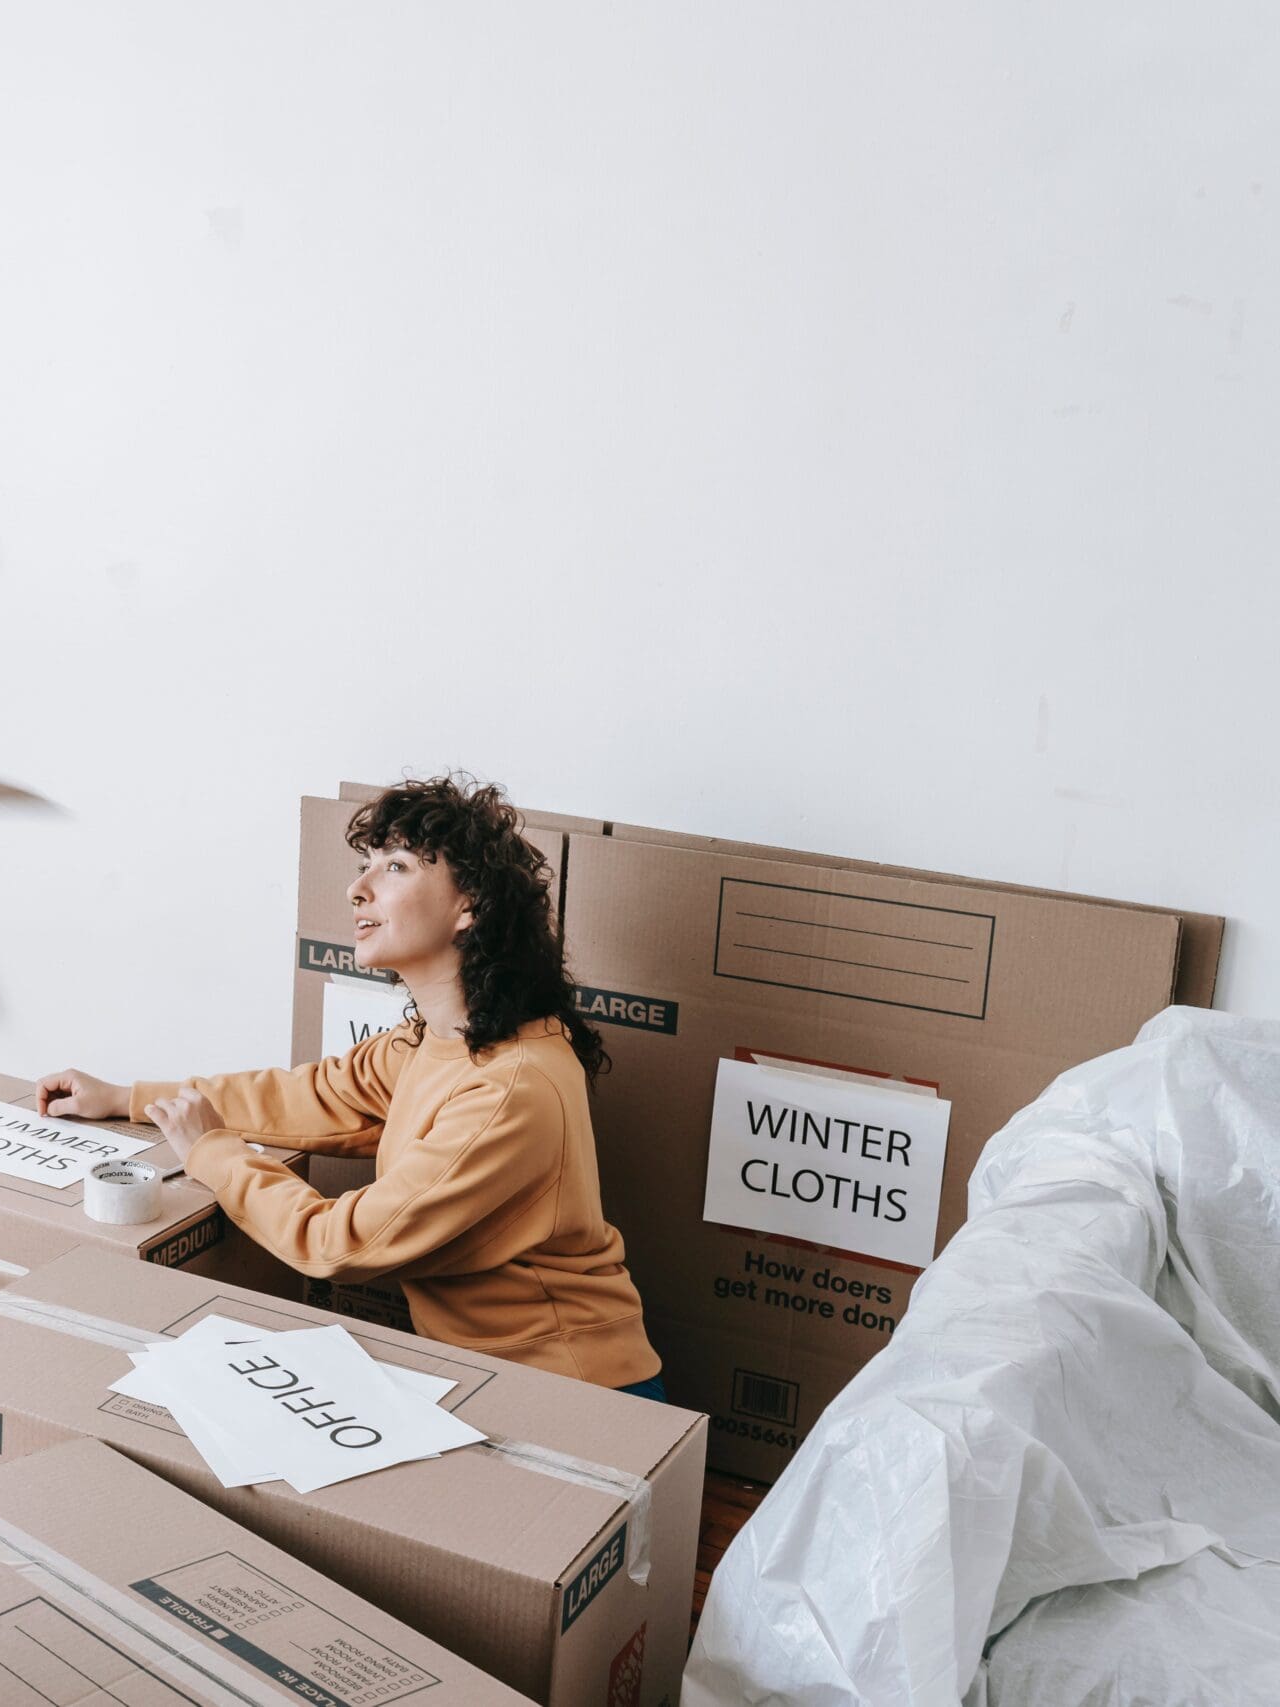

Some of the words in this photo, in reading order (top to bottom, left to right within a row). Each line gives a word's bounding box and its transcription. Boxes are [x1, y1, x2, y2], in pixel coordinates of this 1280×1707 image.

[575, 991, 666, 1026] LARGE
[746, 1100, 913, 1167] WINTER
[741, 1159, 908, 1222] CLOTHS
[153, 1221, 218, 1267] MEDIUM
[744, 1251, 805, 1283] How
[813, 1268, 892, 1304] doers
[714, 1276, 758, 1301] get
[765, 1287, 834, 1320] more
[843, 1303, 897, 1335] don
[125, 1408, 149, 1419] BATH
[228, 1355, 383, 1448] OFFICE
[568, 1537, 620, 1619] LARGE
[203, 1593, 245, 1618] LAUNDRY
[209, 1585, 257, 1614] BASEMENT
[231, 1586, 268, 1609] GARAGE
[254, 1589, 280, 1605] ATTIC
[160, 1595, 215, 1631] FRAGILE
[194, 1598, 233, 1622] KITCHEN
[310, 1647, 341, 1669] ROOM
[325, 1644, 356, 1664] ROOM
[334, 1638, 365, 1658] ROOM
[277, 1669, 299, 1684] IN:
[314, 1660, 363, 1691] BEDROOM
[340, 1666, 373, 1686] FAMILY
[353, 1661, 386, 1682] LIVING
[364, 1656, 398, 1677] DINING
[382, 1656, 409, 1673] BATH
[295, 1682, 337, 1707] LACE
[311, 1670, 351, 1695] MASTER
